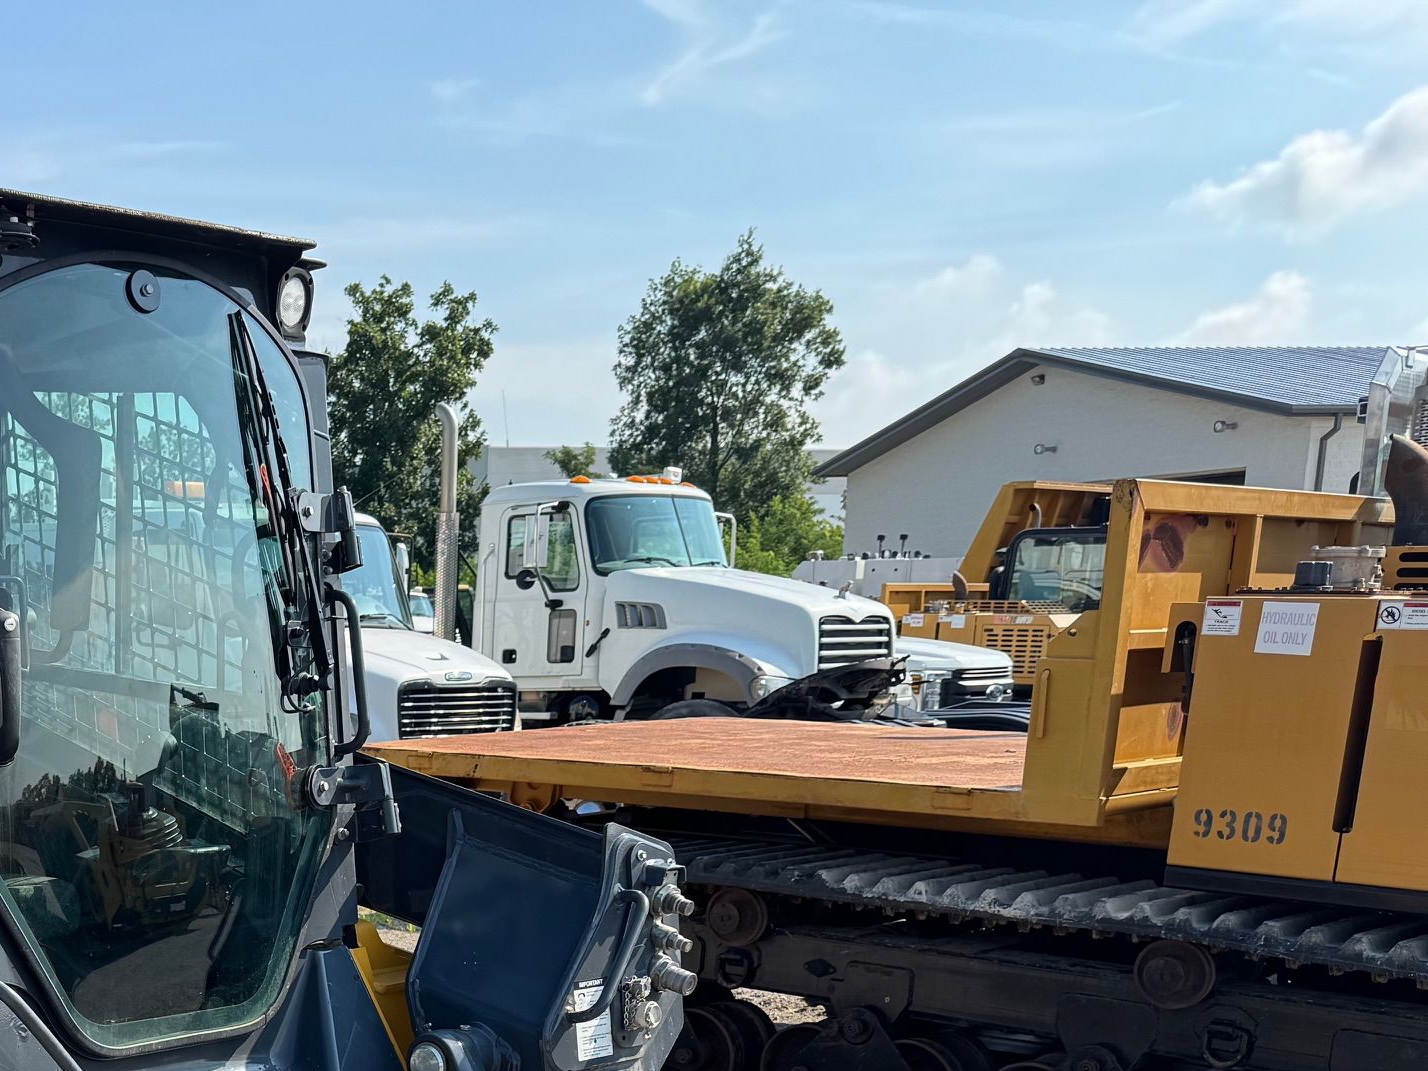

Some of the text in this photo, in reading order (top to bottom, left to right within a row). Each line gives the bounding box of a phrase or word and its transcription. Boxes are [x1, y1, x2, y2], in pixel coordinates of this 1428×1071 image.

[1262, 611, 1316, 627] HYDRAULIC
[1263, 630, 1308, 646] OIL ONLY
[1193, 808, 1288, 845] 9309
